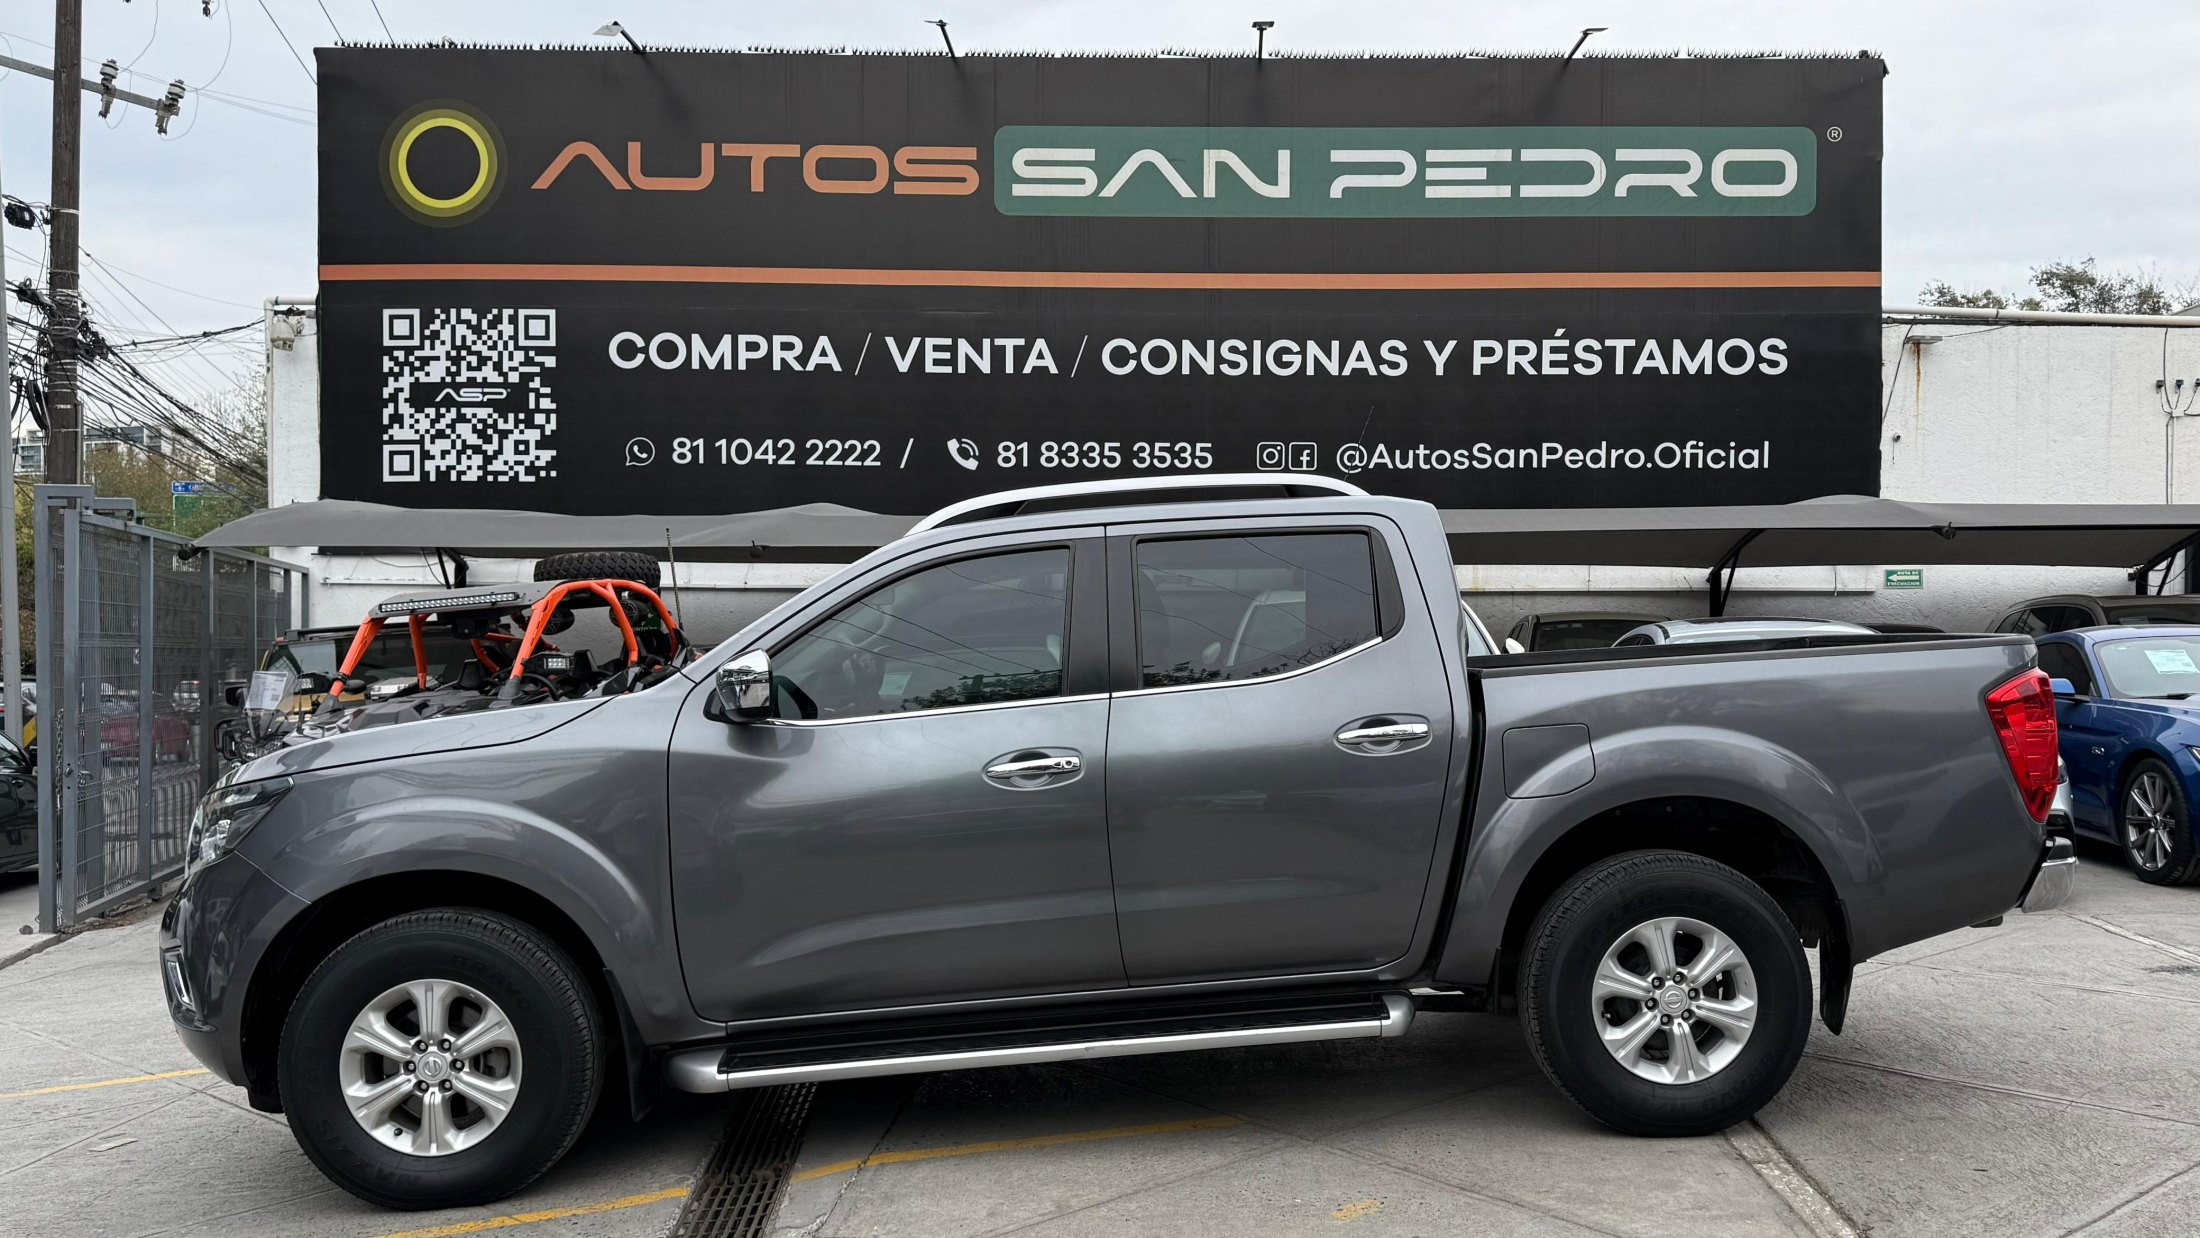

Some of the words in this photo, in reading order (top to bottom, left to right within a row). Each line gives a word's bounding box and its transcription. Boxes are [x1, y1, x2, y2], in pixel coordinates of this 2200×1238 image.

[531, 141, 980, 197] AUTOS
[1011, 147, 1291, 200] SAN
[1330, 148, 1799, 200] PEDRO
[608, 331, 843, 372] COMPRA
[884, 336, 1059, 374] VENTA
[1101, 338, 1408, 377] CONSIGNAS
[1422, 339, 1458, 376] Y
[1472, 328, 1789, 377] PRÉSTAMOS
[671, 437, 704, 466] 81
[714, 438, 796, 466] 1042
[805, 438, 882, 467] 2222
[996, 441, 1028, 468] 81
[1039, 440, 1122, 469] 8335
[1132, 441, 1213, 469] 3535
[1335, 440, 1771, 474] @AutosSanPedro.Oficial
